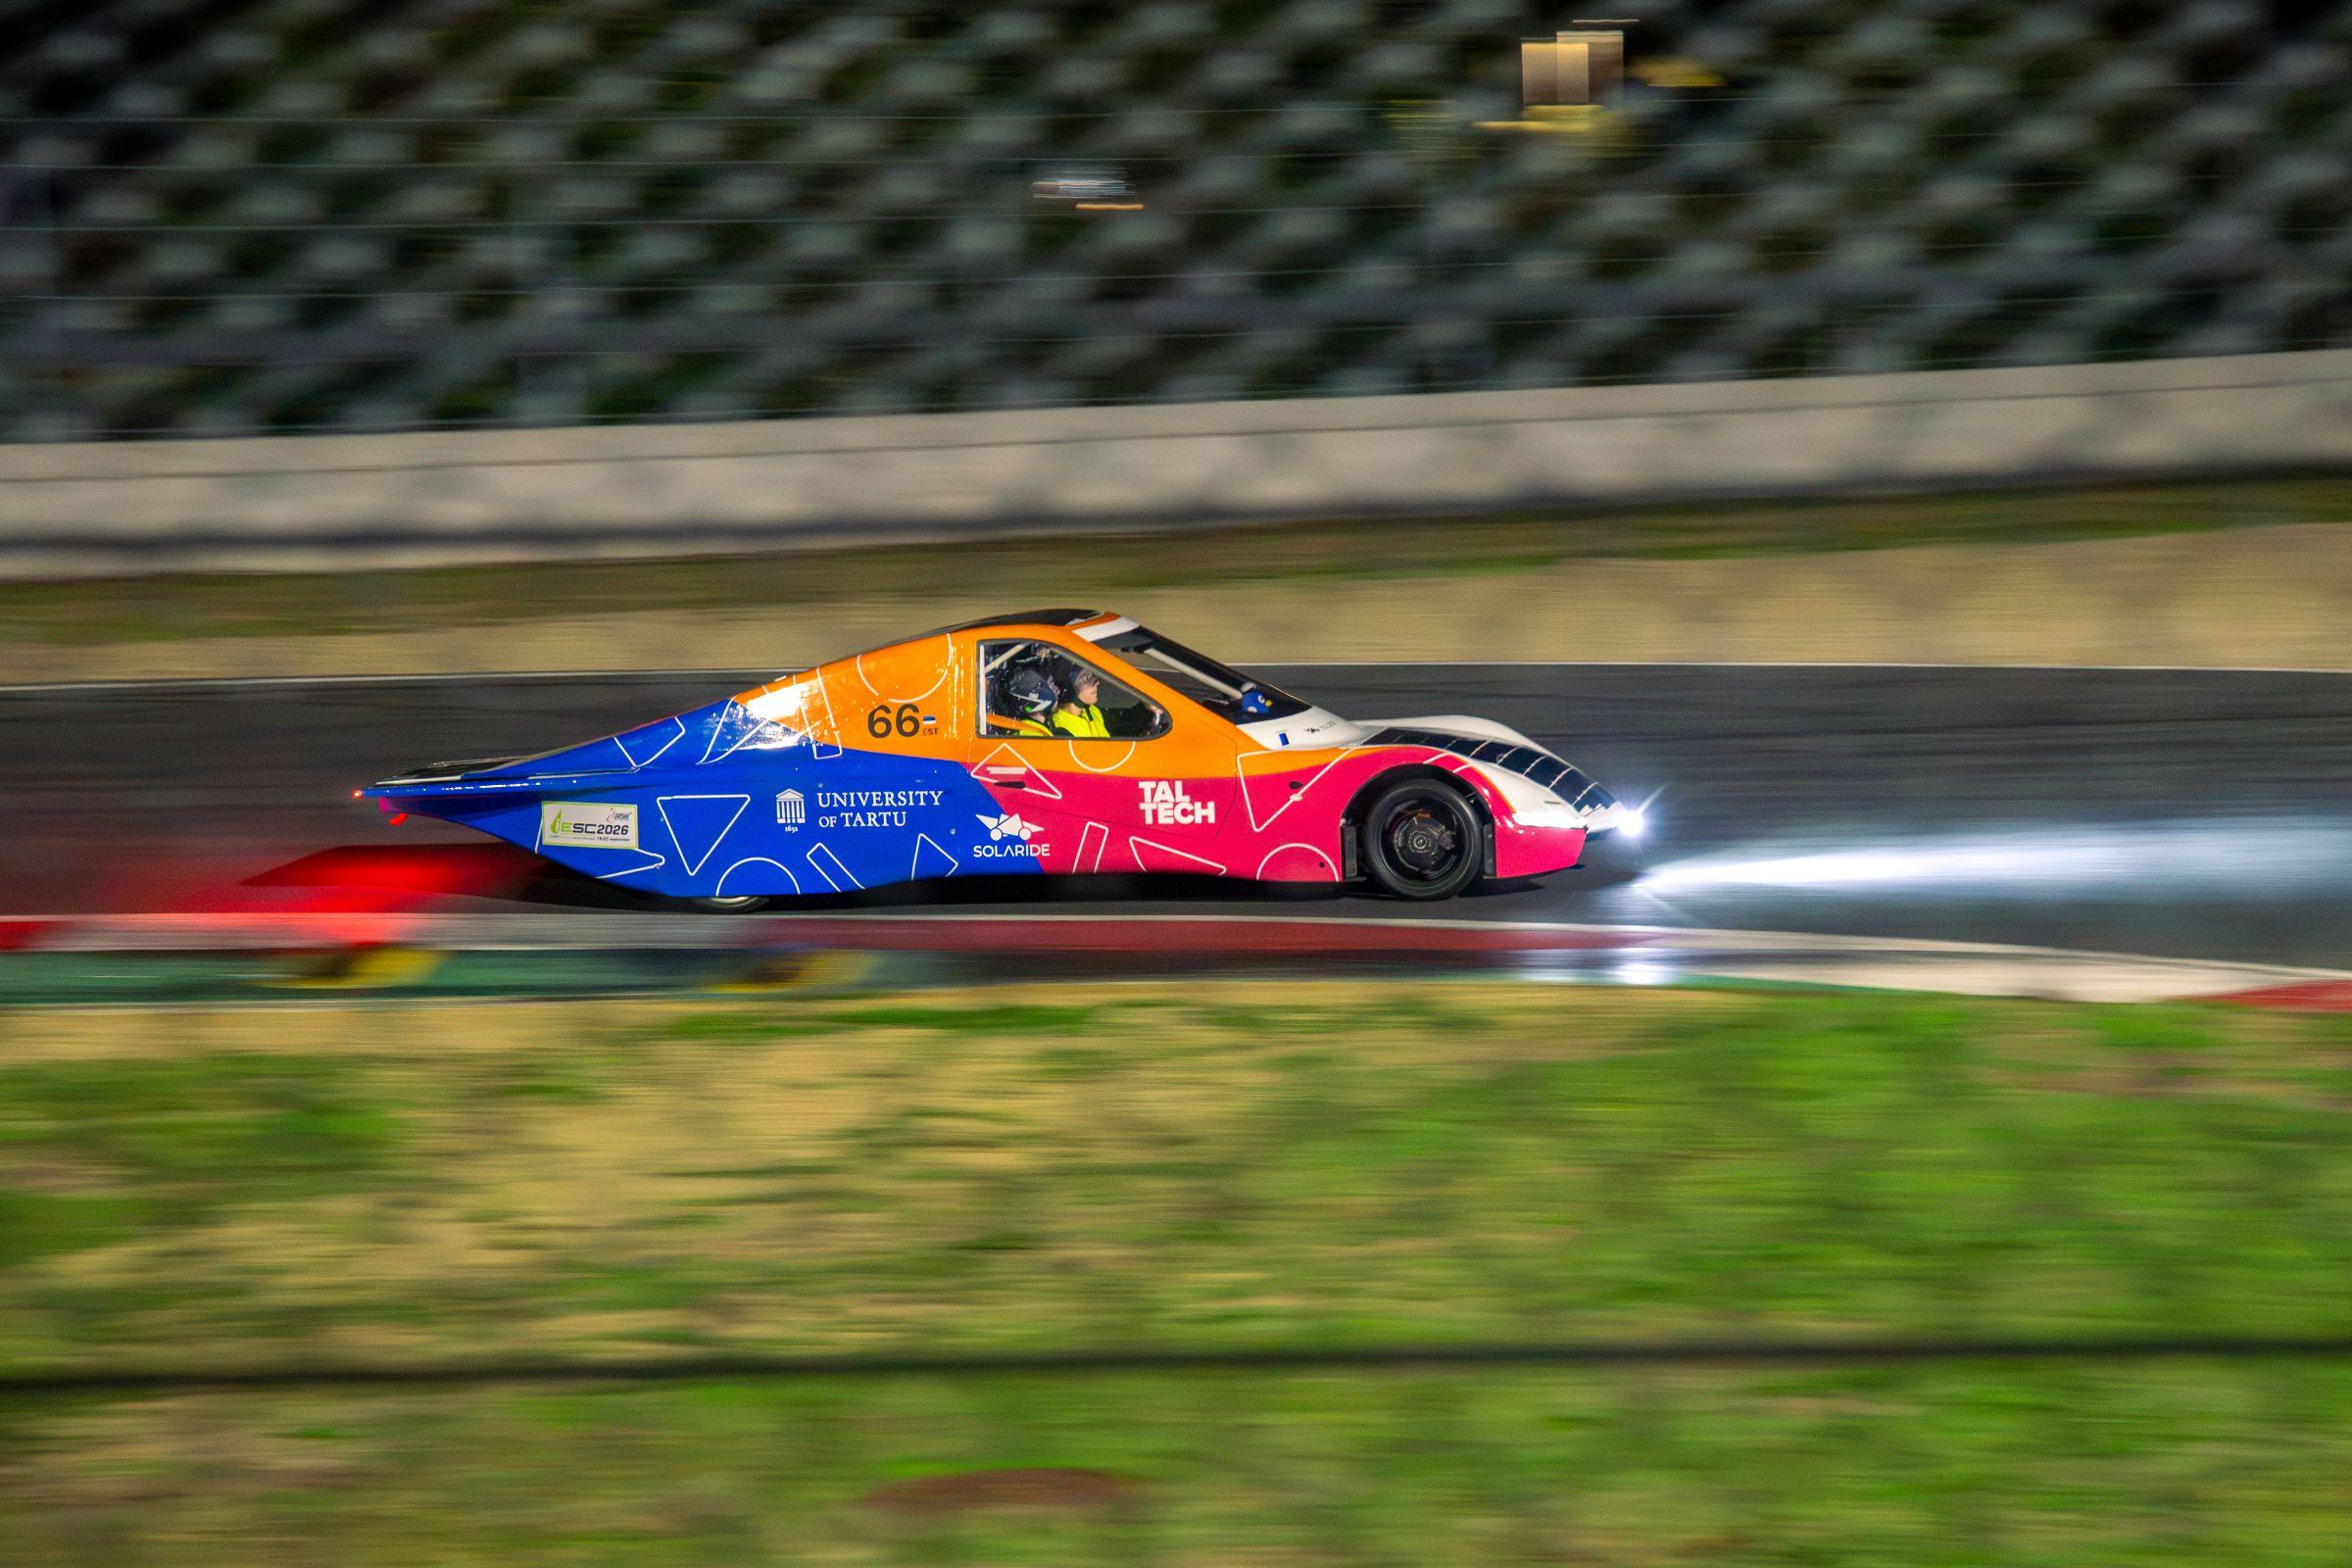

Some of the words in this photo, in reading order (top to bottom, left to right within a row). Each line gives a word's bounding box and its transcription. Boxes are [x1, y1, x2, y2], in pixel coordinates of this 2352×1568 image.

[867, 704, 920, 738] 66
[922, 727, 939, 736] EST
[816, 790, 943, 808] UNIVERSITY
[1139, 781, 1190, 803] TAL
[818, 815, 837, 828] OF
[840, 811, 906, 827] TARTU
[1139, 802, 1216, 824] TECH
[973, 844, 1051, 858] SOLARIDE
